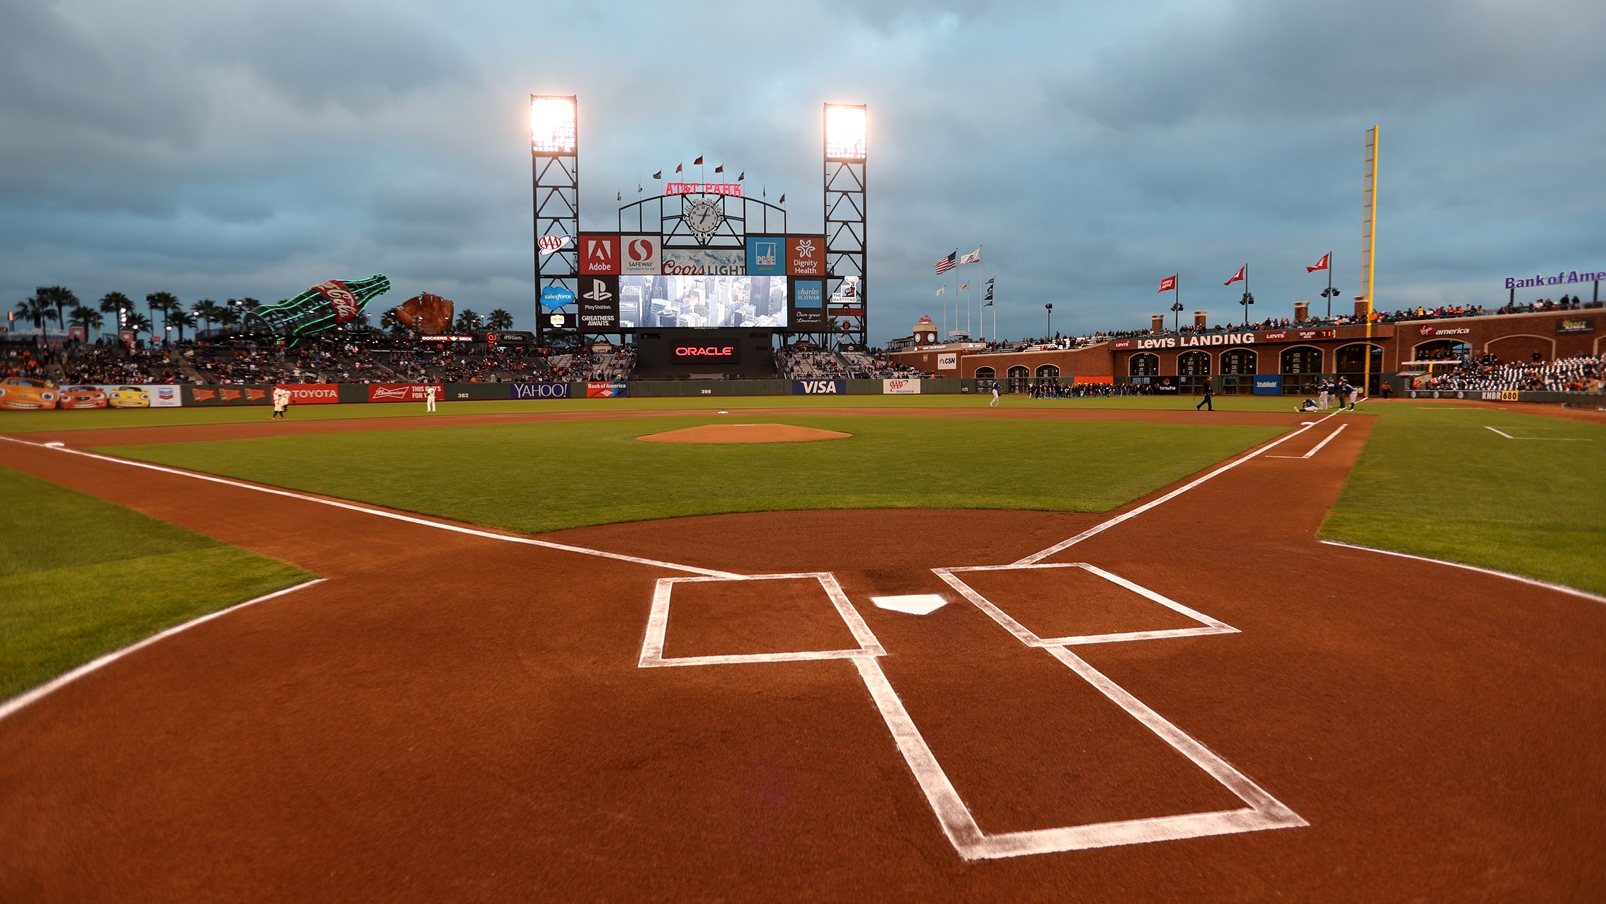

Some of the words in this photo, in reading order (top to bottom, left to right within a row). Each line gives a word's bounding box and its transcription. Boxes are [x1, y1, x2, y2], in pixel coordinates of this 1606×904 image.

[664, 182, 699, 197] AT&T
[704, 183, 742, 197] PARK
[538, 236, 561, 250] AAA
[756, 255, 776, 265] PG&E
[794, 260, 818, 269] Dignity
[588, 262, 611, 271] Adobe
[662, 259, 705, 275] Coors
[707, 265, 746, 275] LIGHT
[1505, 274, 1545, 289] Bank
[1548, 271, 1565, 285] of
[1180, 333, 1254, 347] LANDING
[676, 347, 733, 356] ORACLE
[514, 383, 567, 398] YAHOO!
[800, 381, 836, 393] VISA
[293, 389, 337, 399] TOYOTA
[1481, 391, 1501, 400] KNBR
